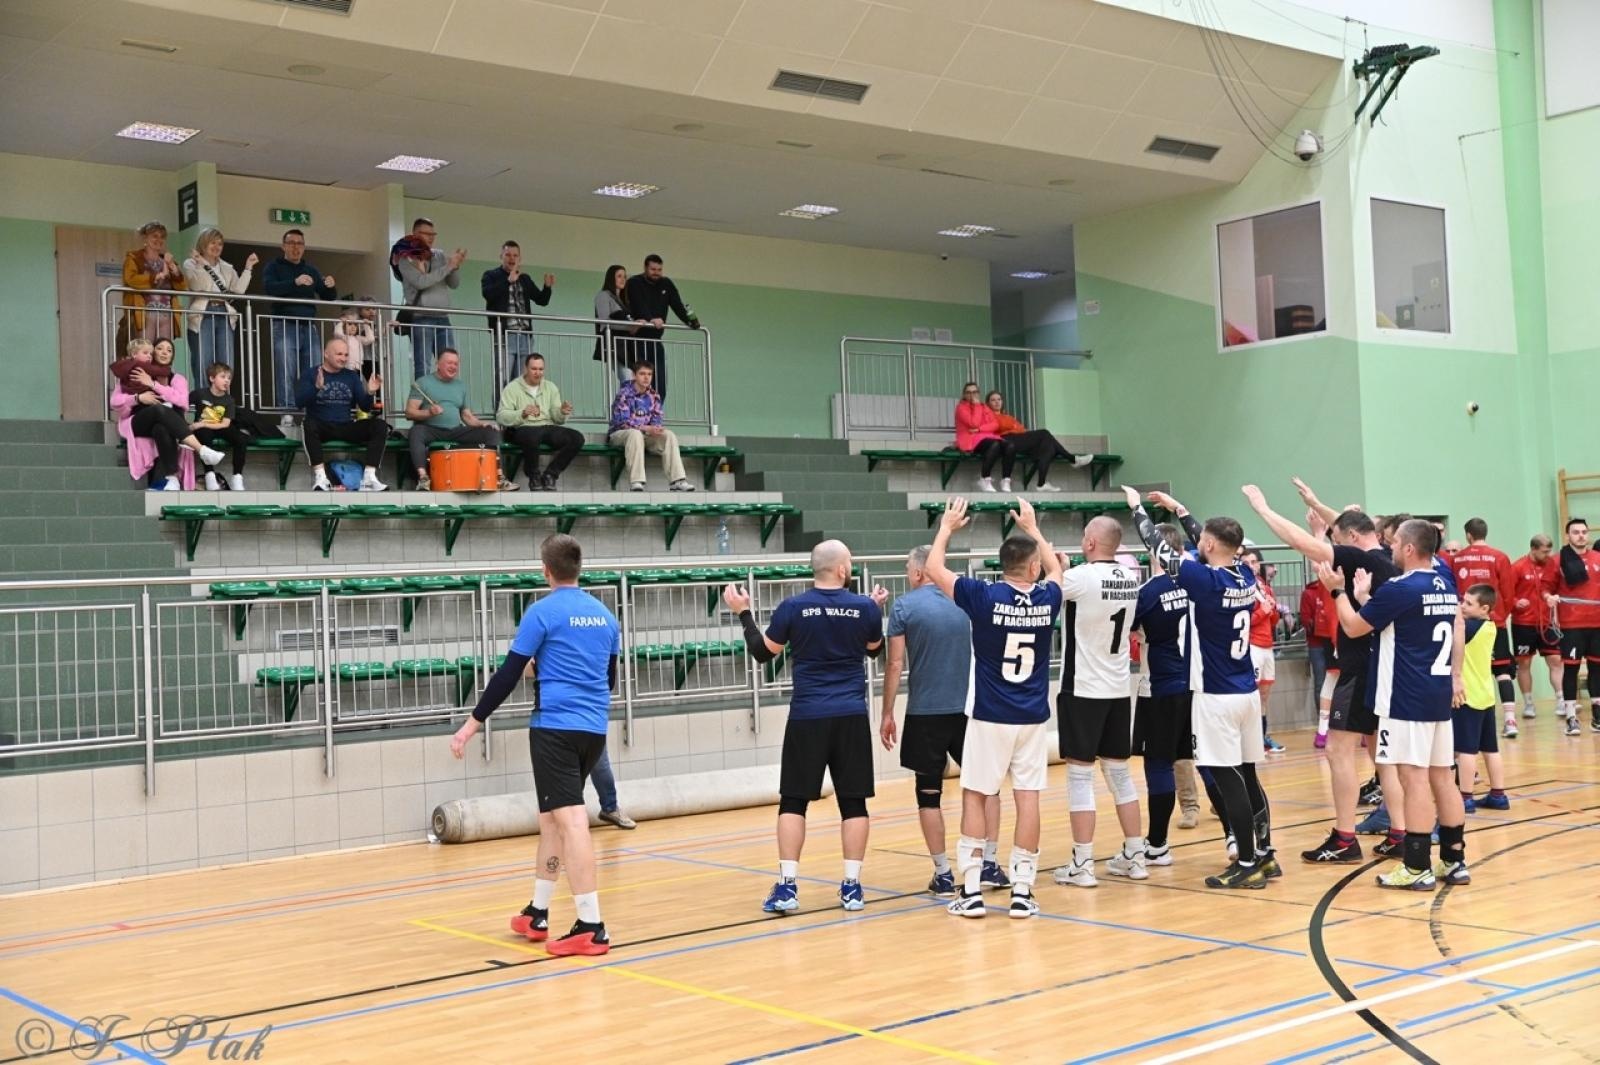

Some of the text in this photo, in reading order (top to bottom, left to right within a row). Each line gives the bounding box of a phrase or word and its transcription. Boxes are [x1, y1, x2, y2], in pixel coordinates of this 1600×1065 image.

[183, 199, 193, 223] F
[1101, 591, 1109, 600] W
[802, 607, 860, 618] SPS WALCE
[993, 602, 1052, 616] ZAKŁAD KARNY
[1162, 601, 1172, 612] W
[569, 616, 608, 627] FARANA
[993, 614, 1051, 627] W RACIBORZU
[1110, 608, 1126, 654] 1
[1230, 610, 1250, 660] 3
[1431, 620, 1453, 676] 2
[1570, 647, 1577, 660] 4
[1001, 633, 1036, 684] 5
